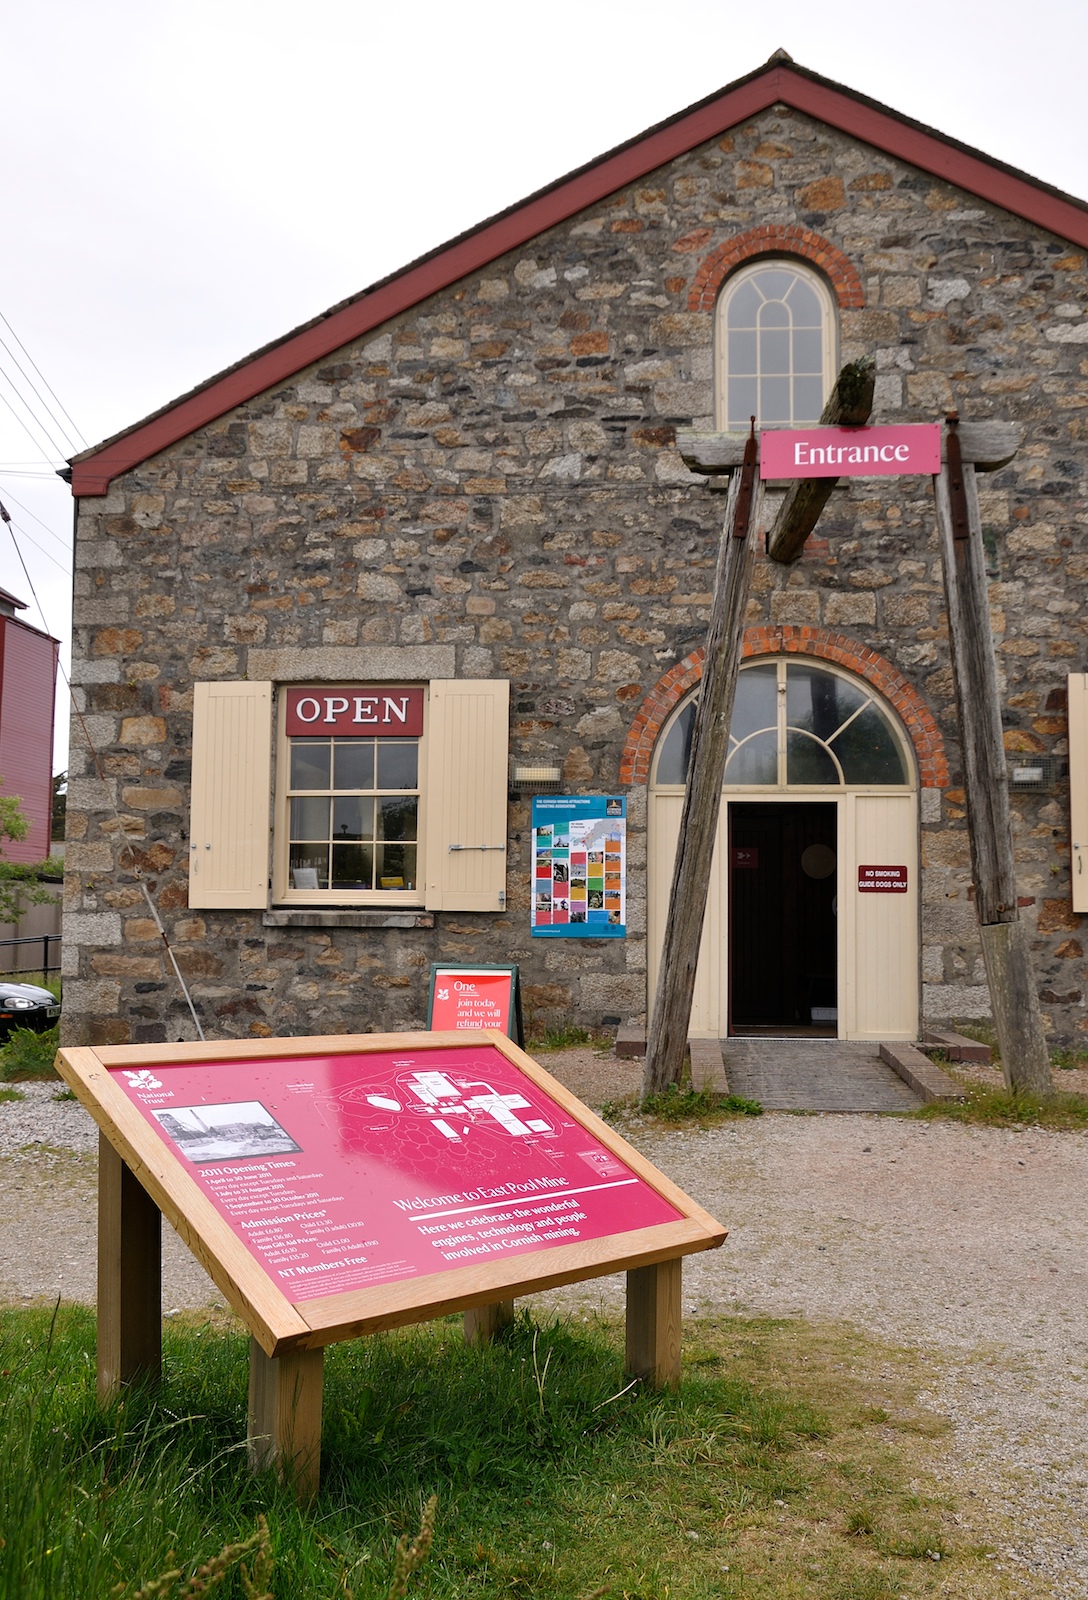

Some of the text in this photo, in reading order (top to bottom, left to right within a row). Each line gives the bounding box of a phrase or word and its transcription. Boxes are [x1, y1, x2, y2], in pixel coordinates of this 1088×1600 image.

[794, 442, 910, 465] Entrance
[296, 697, 409, 722] OPEN
[454, 981, 475, 991] One
[457, 999, 496, 1009] join today
[137, 1090, 174, 1099] National
[197, 1168, 223, 1177] 2011
[223, 1164, 268, 1175] Opening
[392, 1176, 569, 1211] Welcome to East Pool Mine
[229, 1201, 264, 1209] September
[241, 1216, 295, 1229] Admission
[417, 1199, 580, 1235] Here we celebrate the wonderful
[431, 1211, 587, 1247] engines, technology and people
[440, 1228, 580, 1260] involved in Cornish mining.
[278, 1256, 368, 1278] NT Members Free
